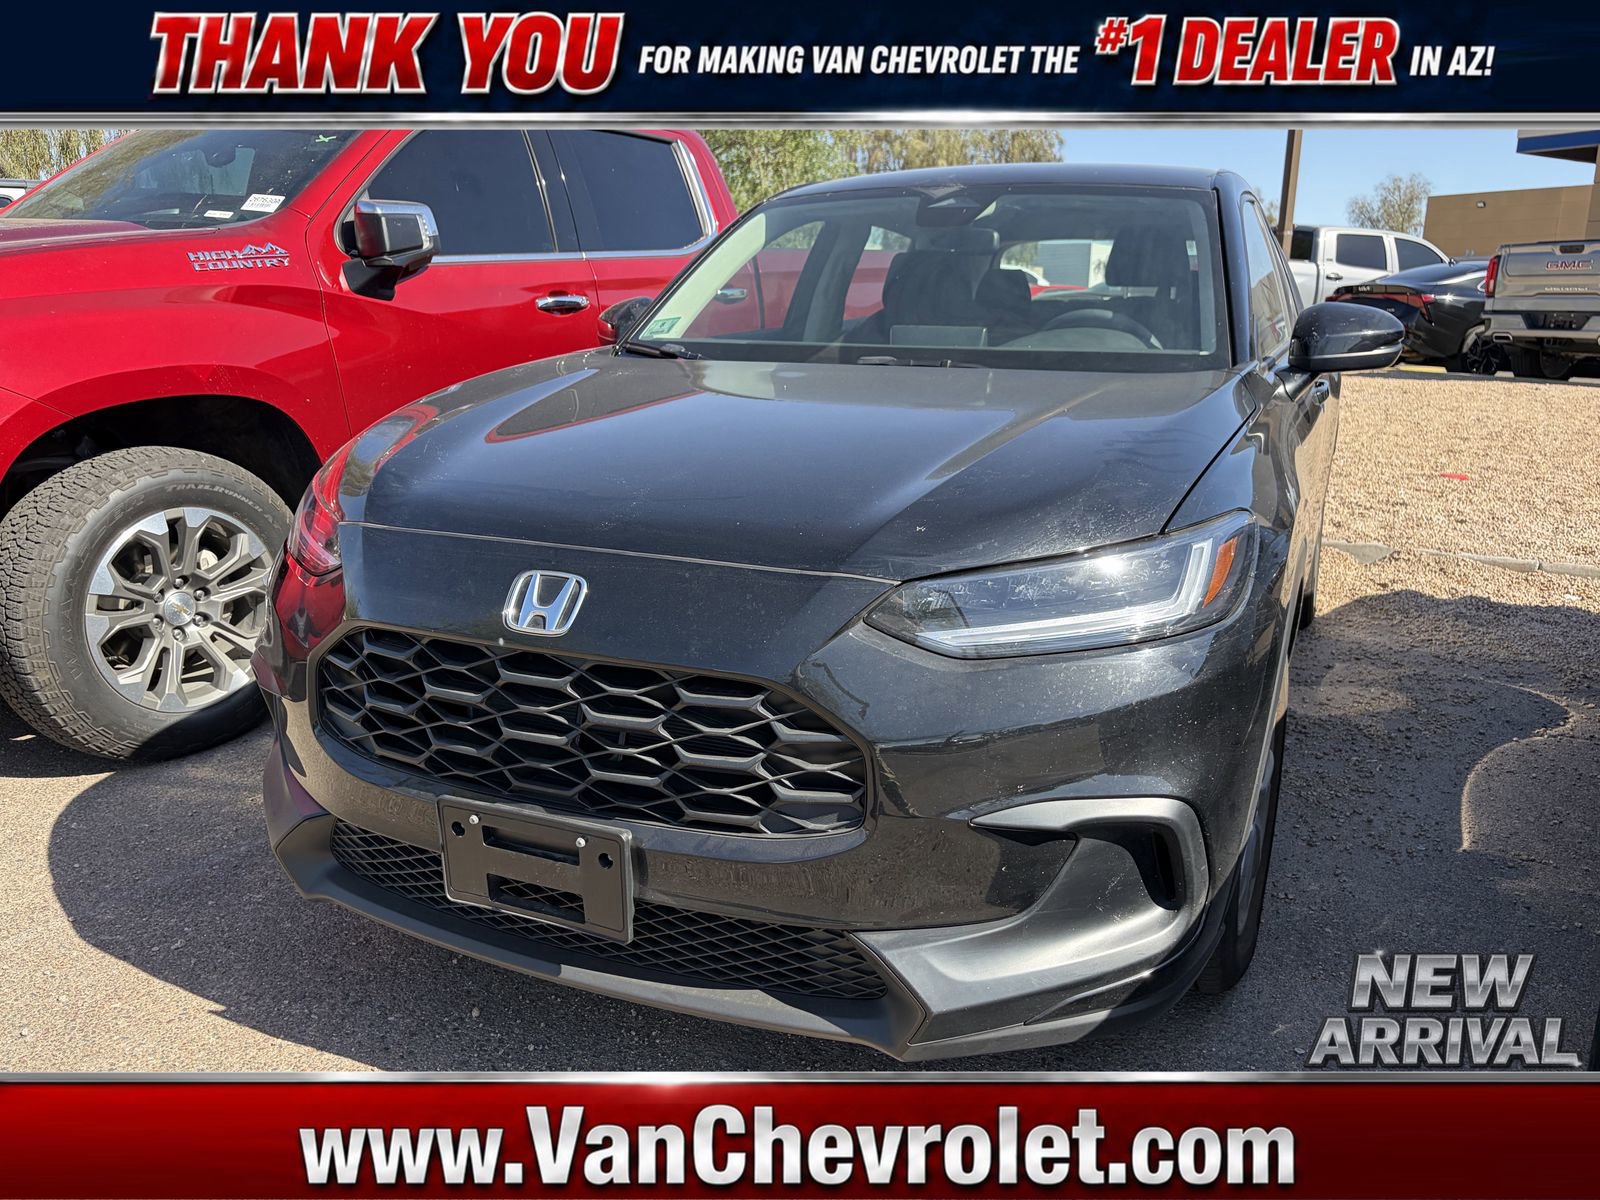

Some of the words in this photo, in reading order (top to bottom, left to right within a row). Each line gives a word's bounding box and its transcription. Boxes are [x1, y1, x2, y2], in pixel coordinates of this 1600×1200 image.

[187, 251, 246, 262] HIGH
[194, 257, 290, 272] COUNTRY
[1545, 260, 1593, 271] GMC
